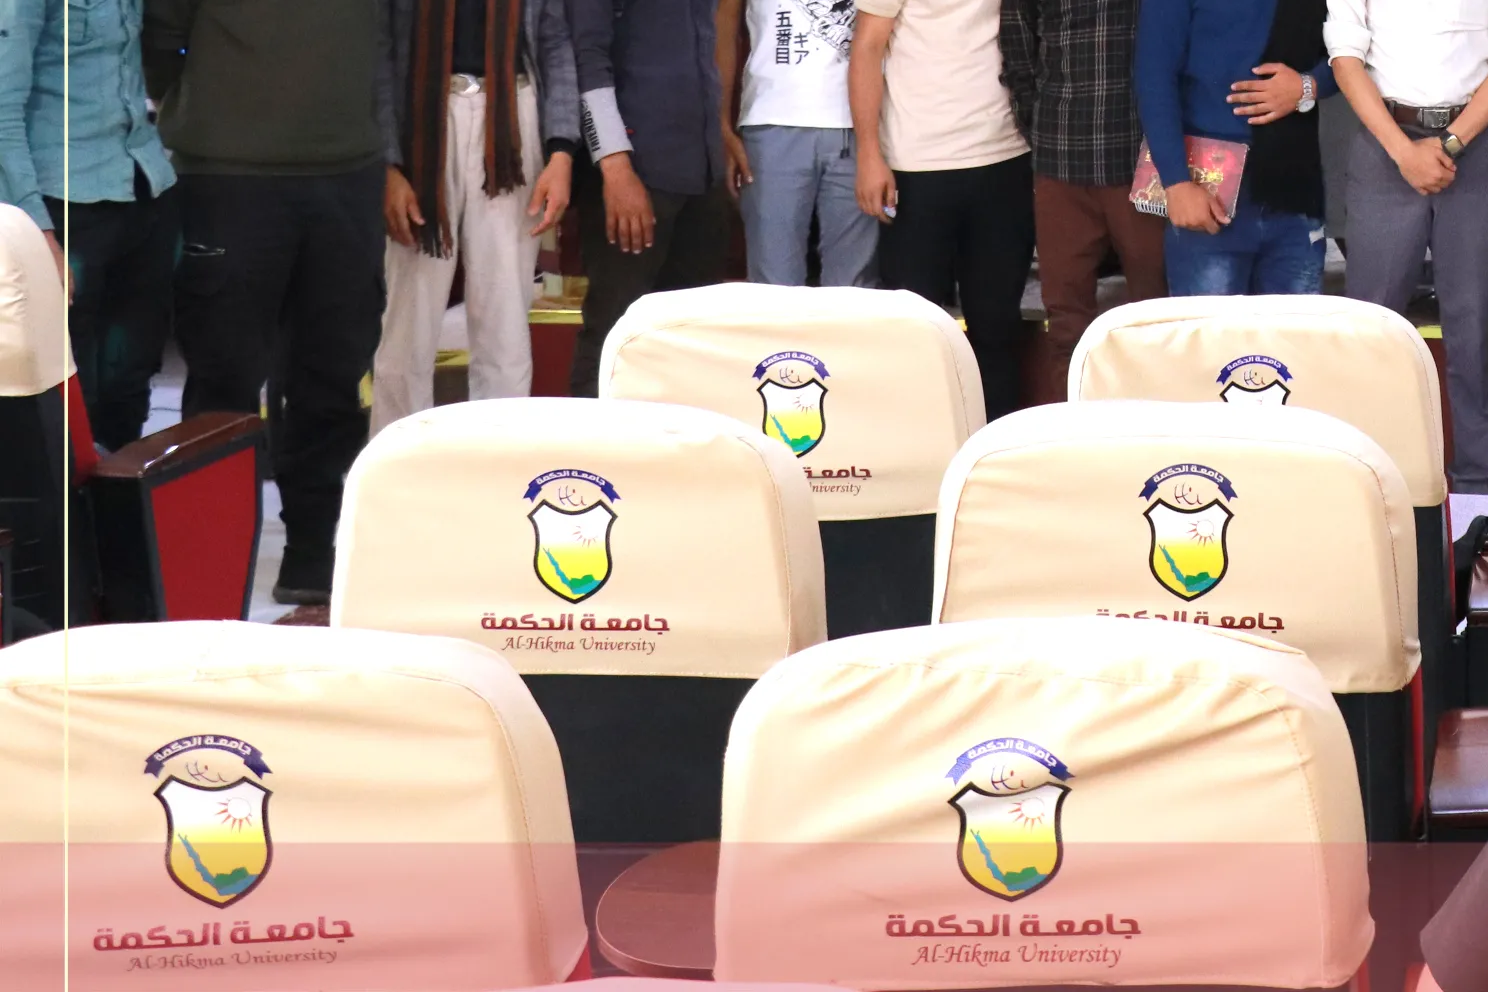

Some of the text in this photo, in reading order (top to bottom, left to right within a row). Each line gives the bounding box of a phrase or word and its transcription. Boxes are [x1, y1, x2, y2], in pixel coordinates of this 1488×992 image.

[775, 10, 793, 65] 五番目
[803, 466, 872, 480] جامعة
[809, 482, 861, 496] niversity
[481, 612, 670, 635] جامعة الحكمة
[1196, 611, 1284, 633] جامعة
[502, 636, 656, 655] Al-Hikma University
[154, 735, 252, 762] جامعة الحكمة
[967, 740, 1058, 768] جامعة الحكمة
[93, 916, 355, 951] جامعة الحكمة
[885, 913, 1142, 940] جامعة الحكمة
[126, 948, 338, 972] Al-Hikma University
[911, 944, 1122, 968] Al-Hikma University
